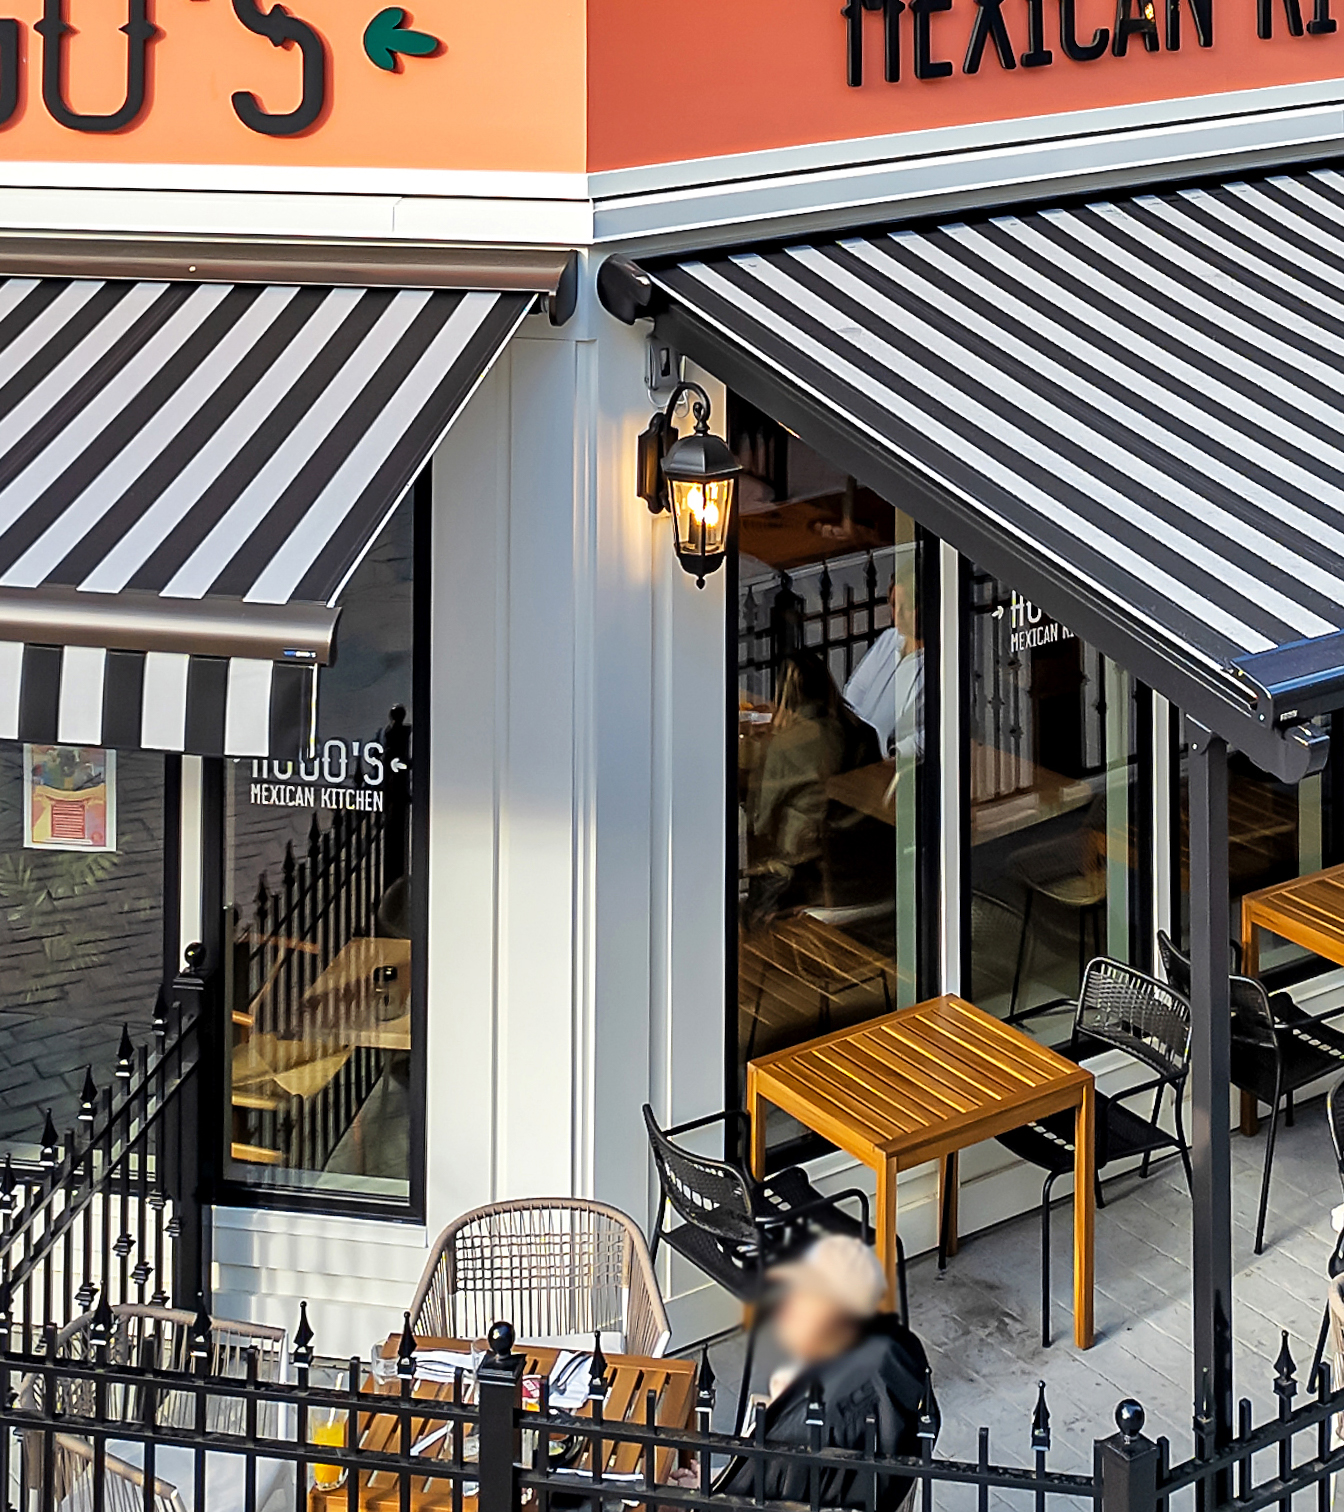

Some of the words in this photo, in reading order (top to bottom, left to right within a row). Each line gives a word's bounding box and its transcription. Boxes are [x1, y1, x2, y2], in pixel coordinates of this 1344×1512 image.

[1010, 622, 1058, 653] MEXICAN
[250, 783, 315, 807] MEXICAN
[321, 788, 384, 812] KITCHEN
